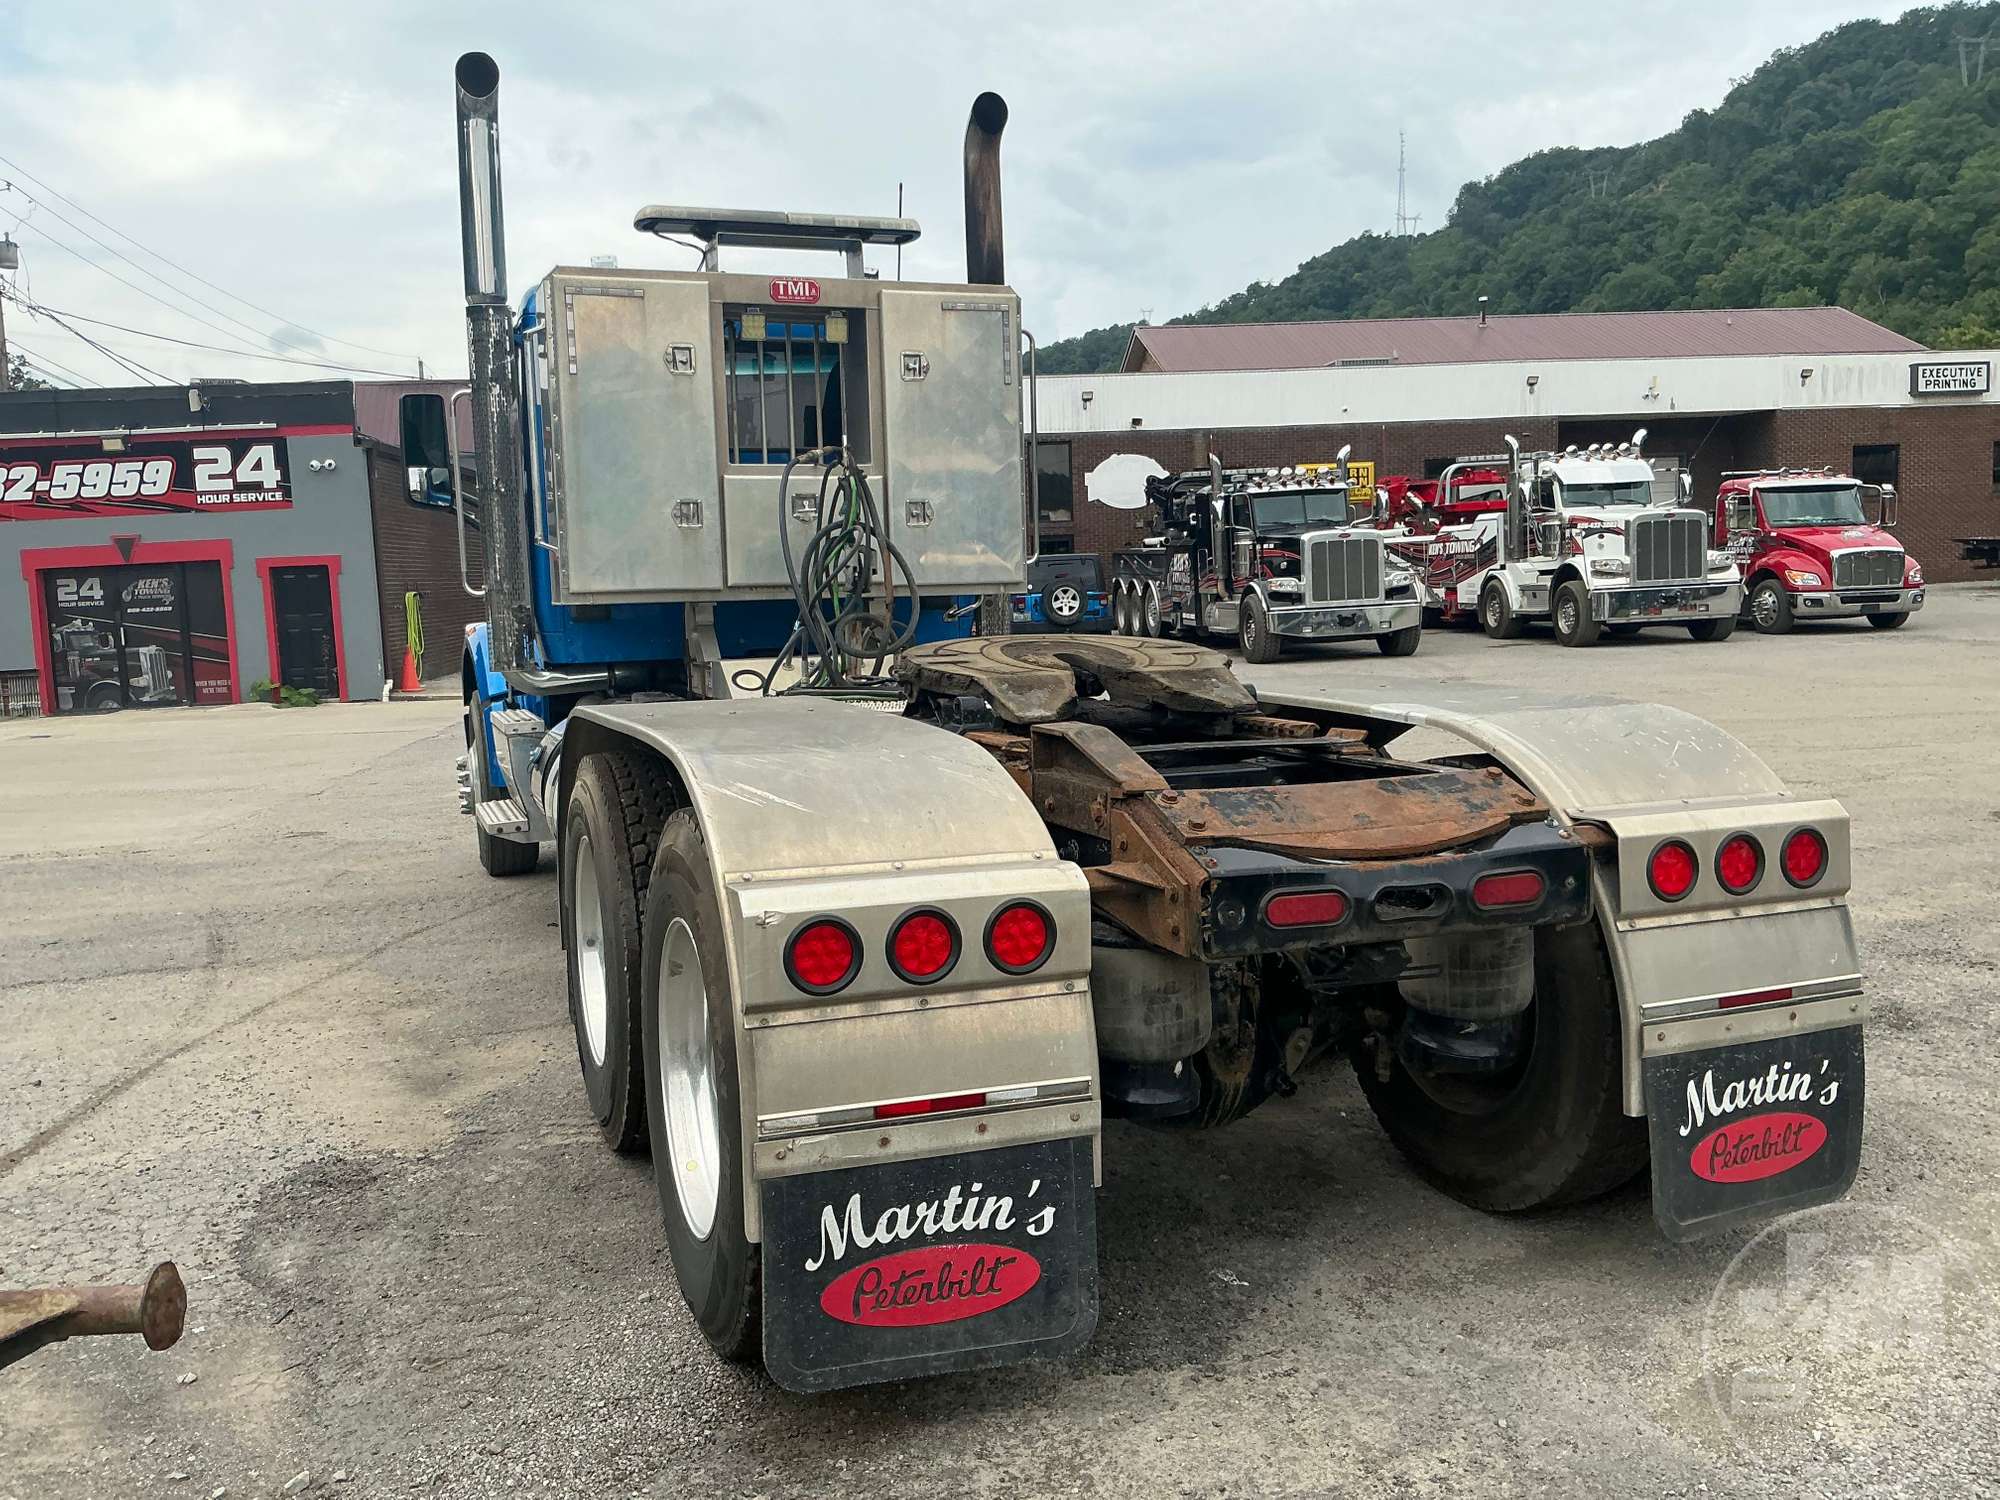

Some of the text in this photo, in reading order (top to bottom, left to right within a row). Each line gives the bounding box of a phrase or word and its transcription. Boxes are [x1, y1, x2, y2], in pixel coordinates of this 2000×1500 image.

[776, 281, 810, 297] TMI
[1921, 367, 1983, 379] EXECUTIVE
[1924, 378, 1977, 390] PRINTING
[192, 445, 281, 492] 24
[196, 491, 284, 504] HOUR SERVICE
[1445, 540, 1475, 554] TOWING
[56, 577, 104, 602] 24
[1679, 1059, 1840, 1137] Martin's
[1709, 1121, 1813, 1177] Peterbilt
[804, 1179, 1057, 1272] Martin's
[851, 1256, 1018, 1321] Peterbilt
